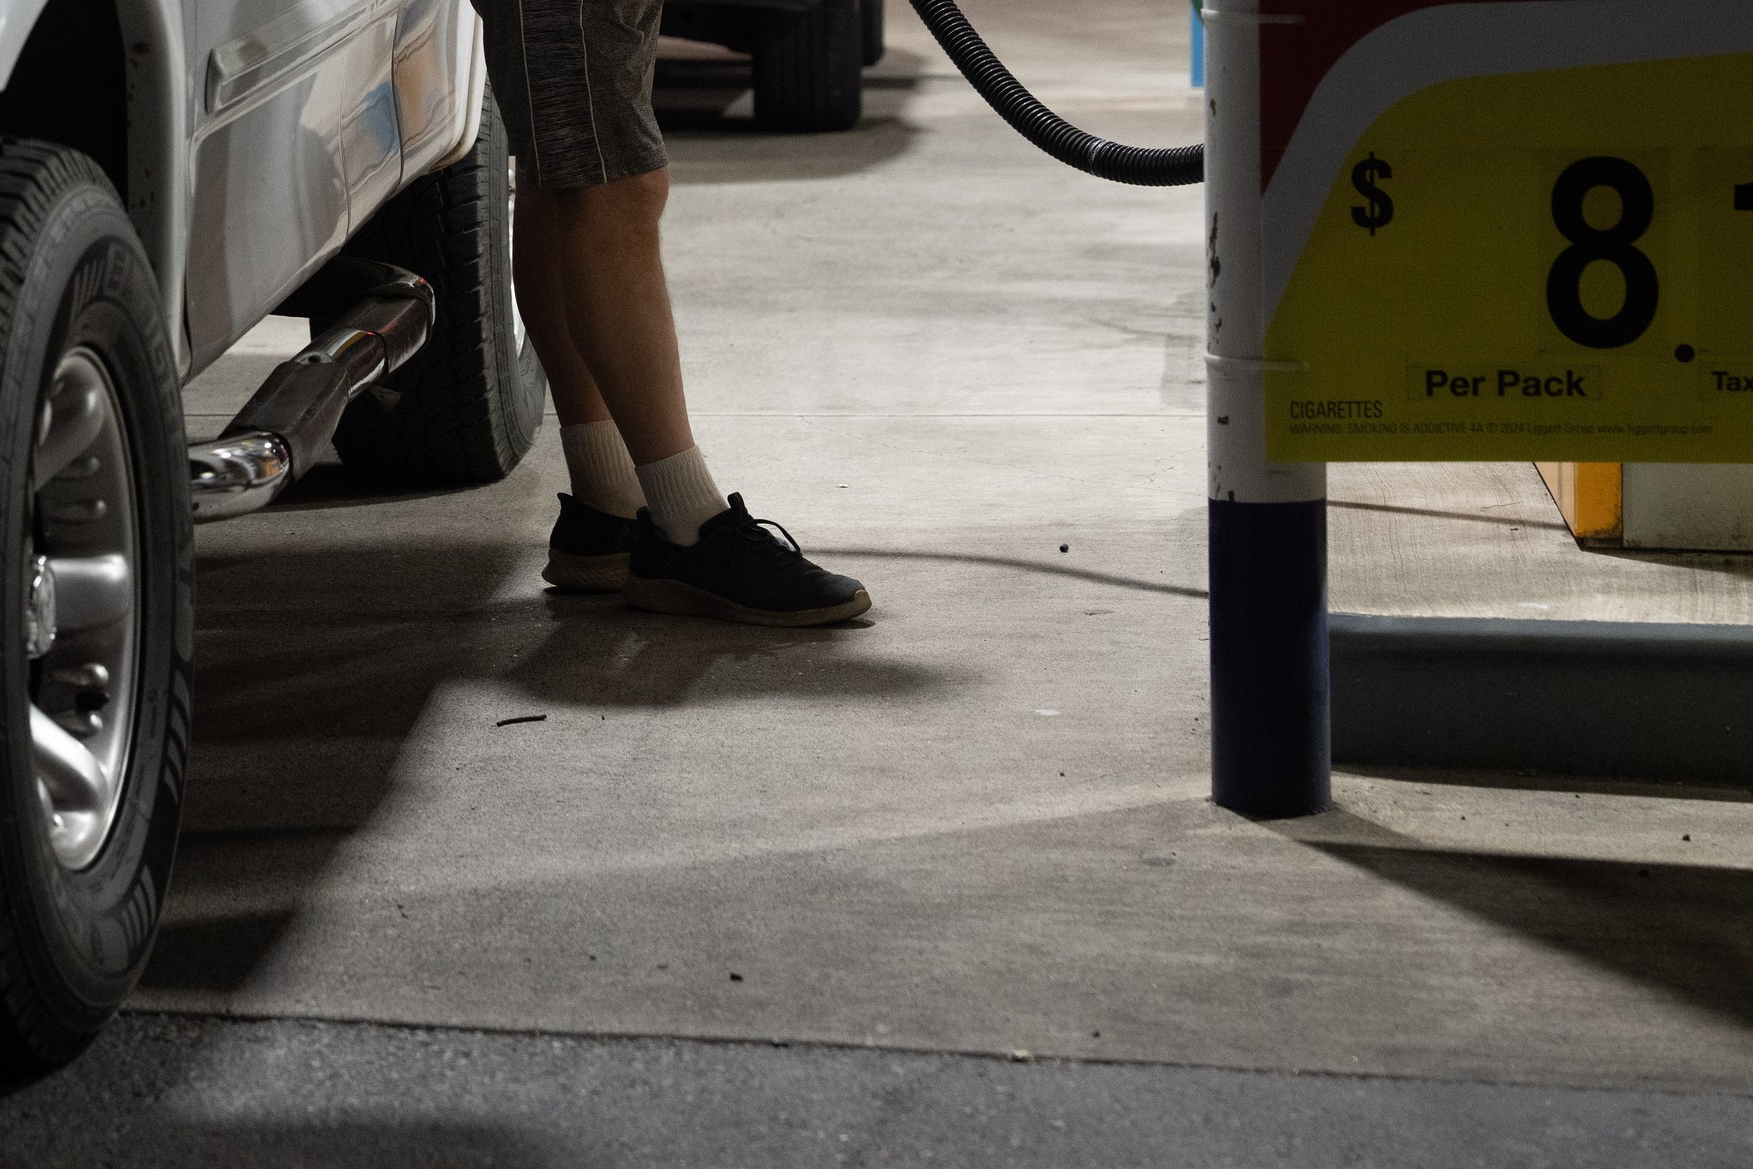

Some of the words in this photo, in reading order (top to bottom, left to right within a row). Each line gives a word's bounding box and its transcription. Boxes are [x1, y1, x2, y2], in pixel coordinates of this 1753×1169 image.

[1425, 370, 1486, 397] Per
[1497, 370, 1586, 398] Pack
[1289, 400, 1383, 419] CIGARETTES
[1347, 422, 1398, 435] SMOKING
[1400, 422, 1411, 434] IS
[1413, 422, 1467, 434] ADDICTIVE
[1500, 422, 1525, 434] 2024
[1527, 422, 1561, 436] Liggett
[1565, 422, 1595, 435] Group
